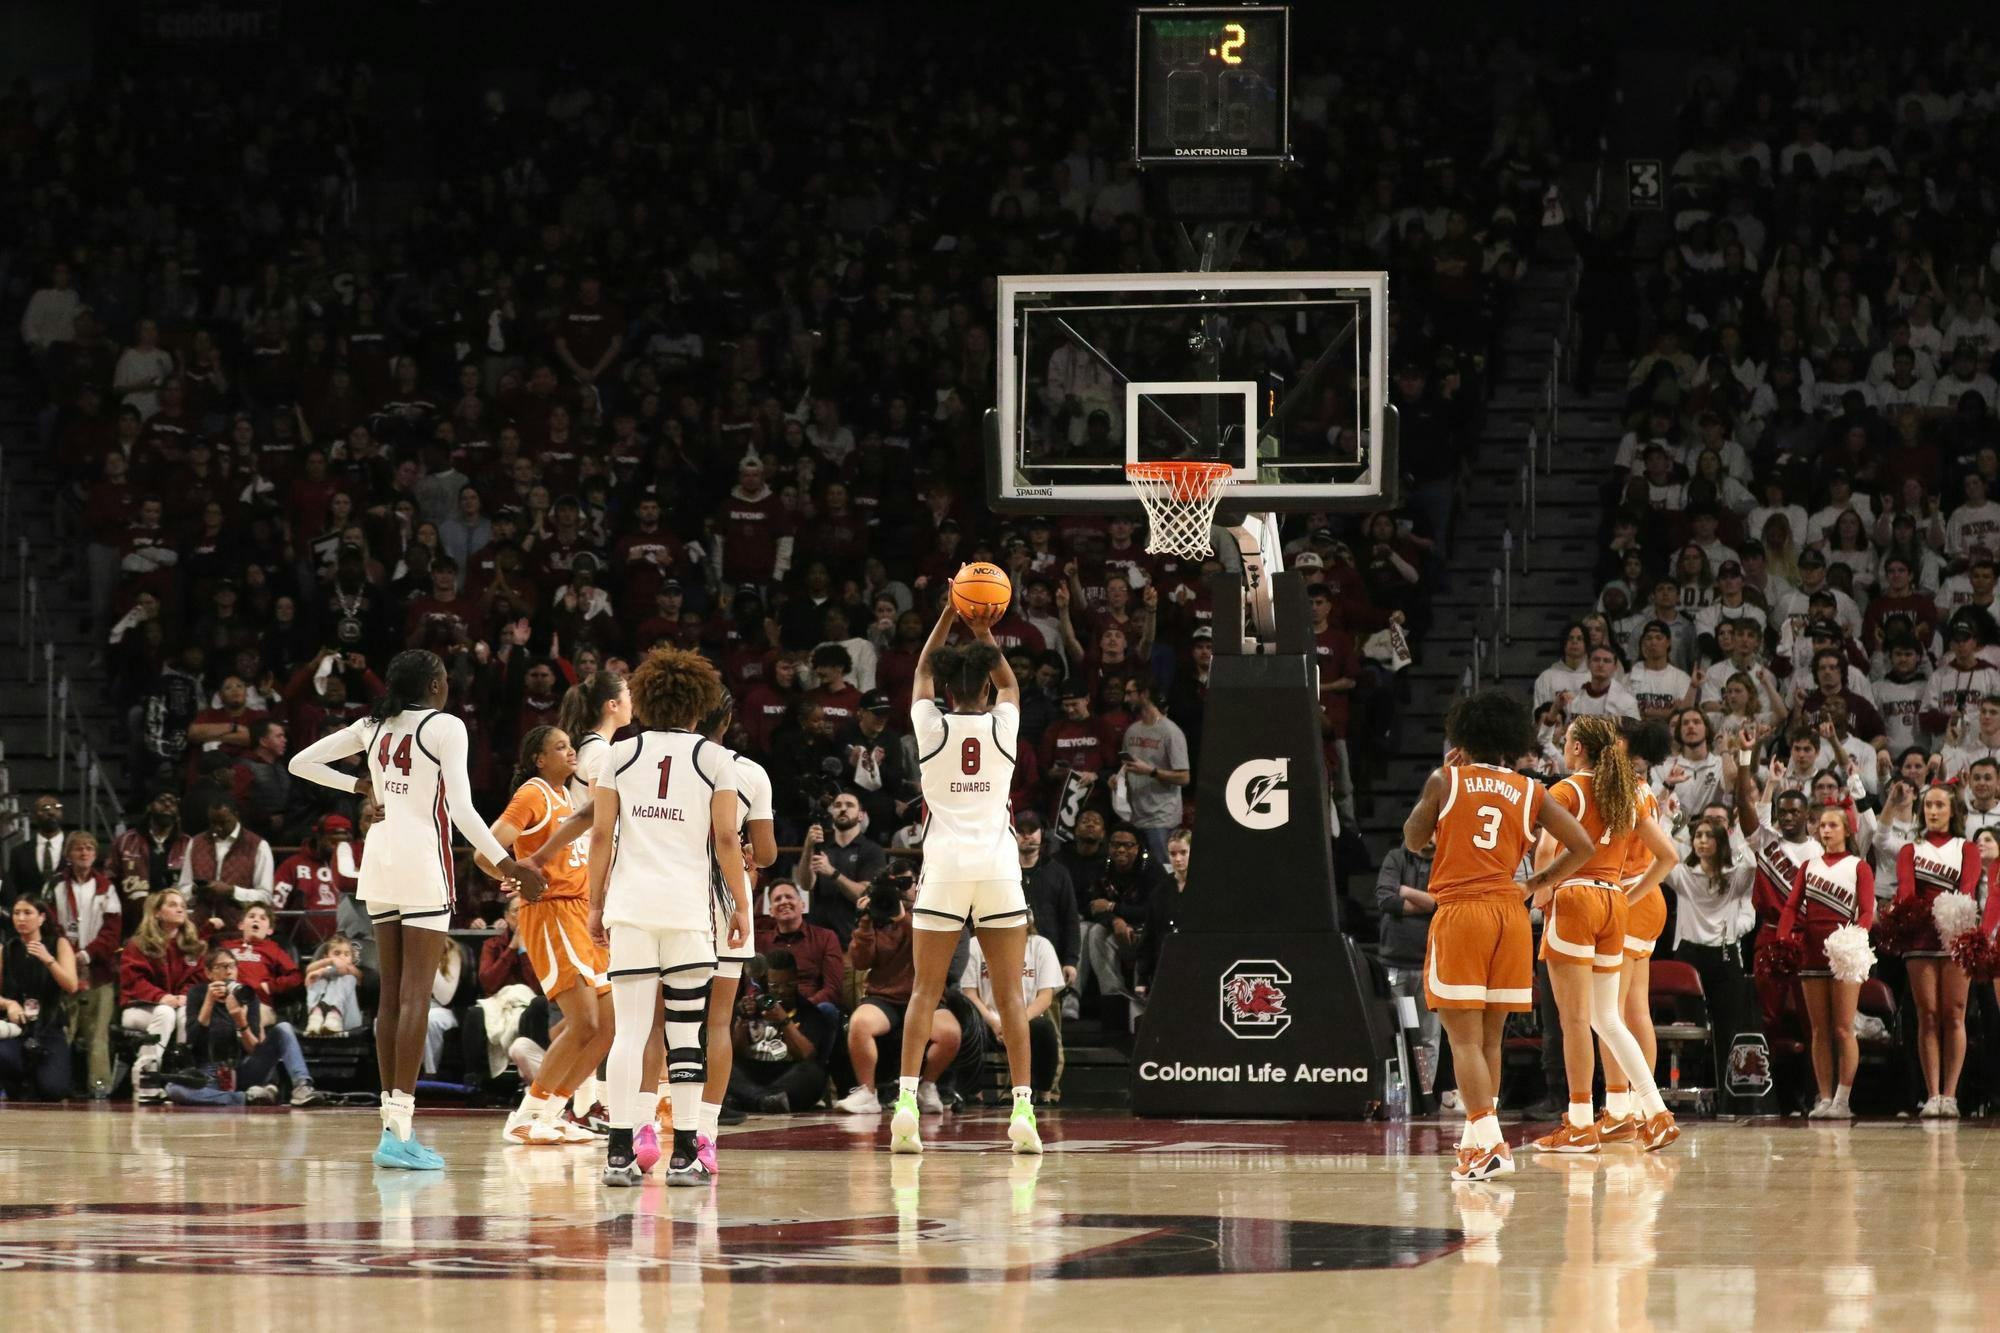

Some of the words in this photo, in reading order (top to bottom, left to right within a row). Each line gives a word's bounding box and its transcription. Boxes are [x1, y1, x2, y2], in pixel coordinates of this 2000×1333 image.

[1174, 148, 1248, 156] DAKTRONICS
[1015, 487, 1053, 497] SPALDING
[377, 732, 413, 776] 44
[1056, 736, 1099, 748] BEYOND
[961, 737, 981, 775] 8
[657, 755, 672, 799] 1
[950, 781, 991, 793] EDWARDS
[1463, 776, 1522, 806] HARMON
[632, 804, 686, 822] McDANIEL
[1472, 805, 1503, 850] 3
[1913, 855, 1960, 880] CAROLIN
[1806, 871, 1854, 907] CAROLINA
[1139, 1061, 1241, 1083] Colonial
[1248, 1062, 1287, 1083] Life
[1293, 1063, 1369, 1084] Arena
